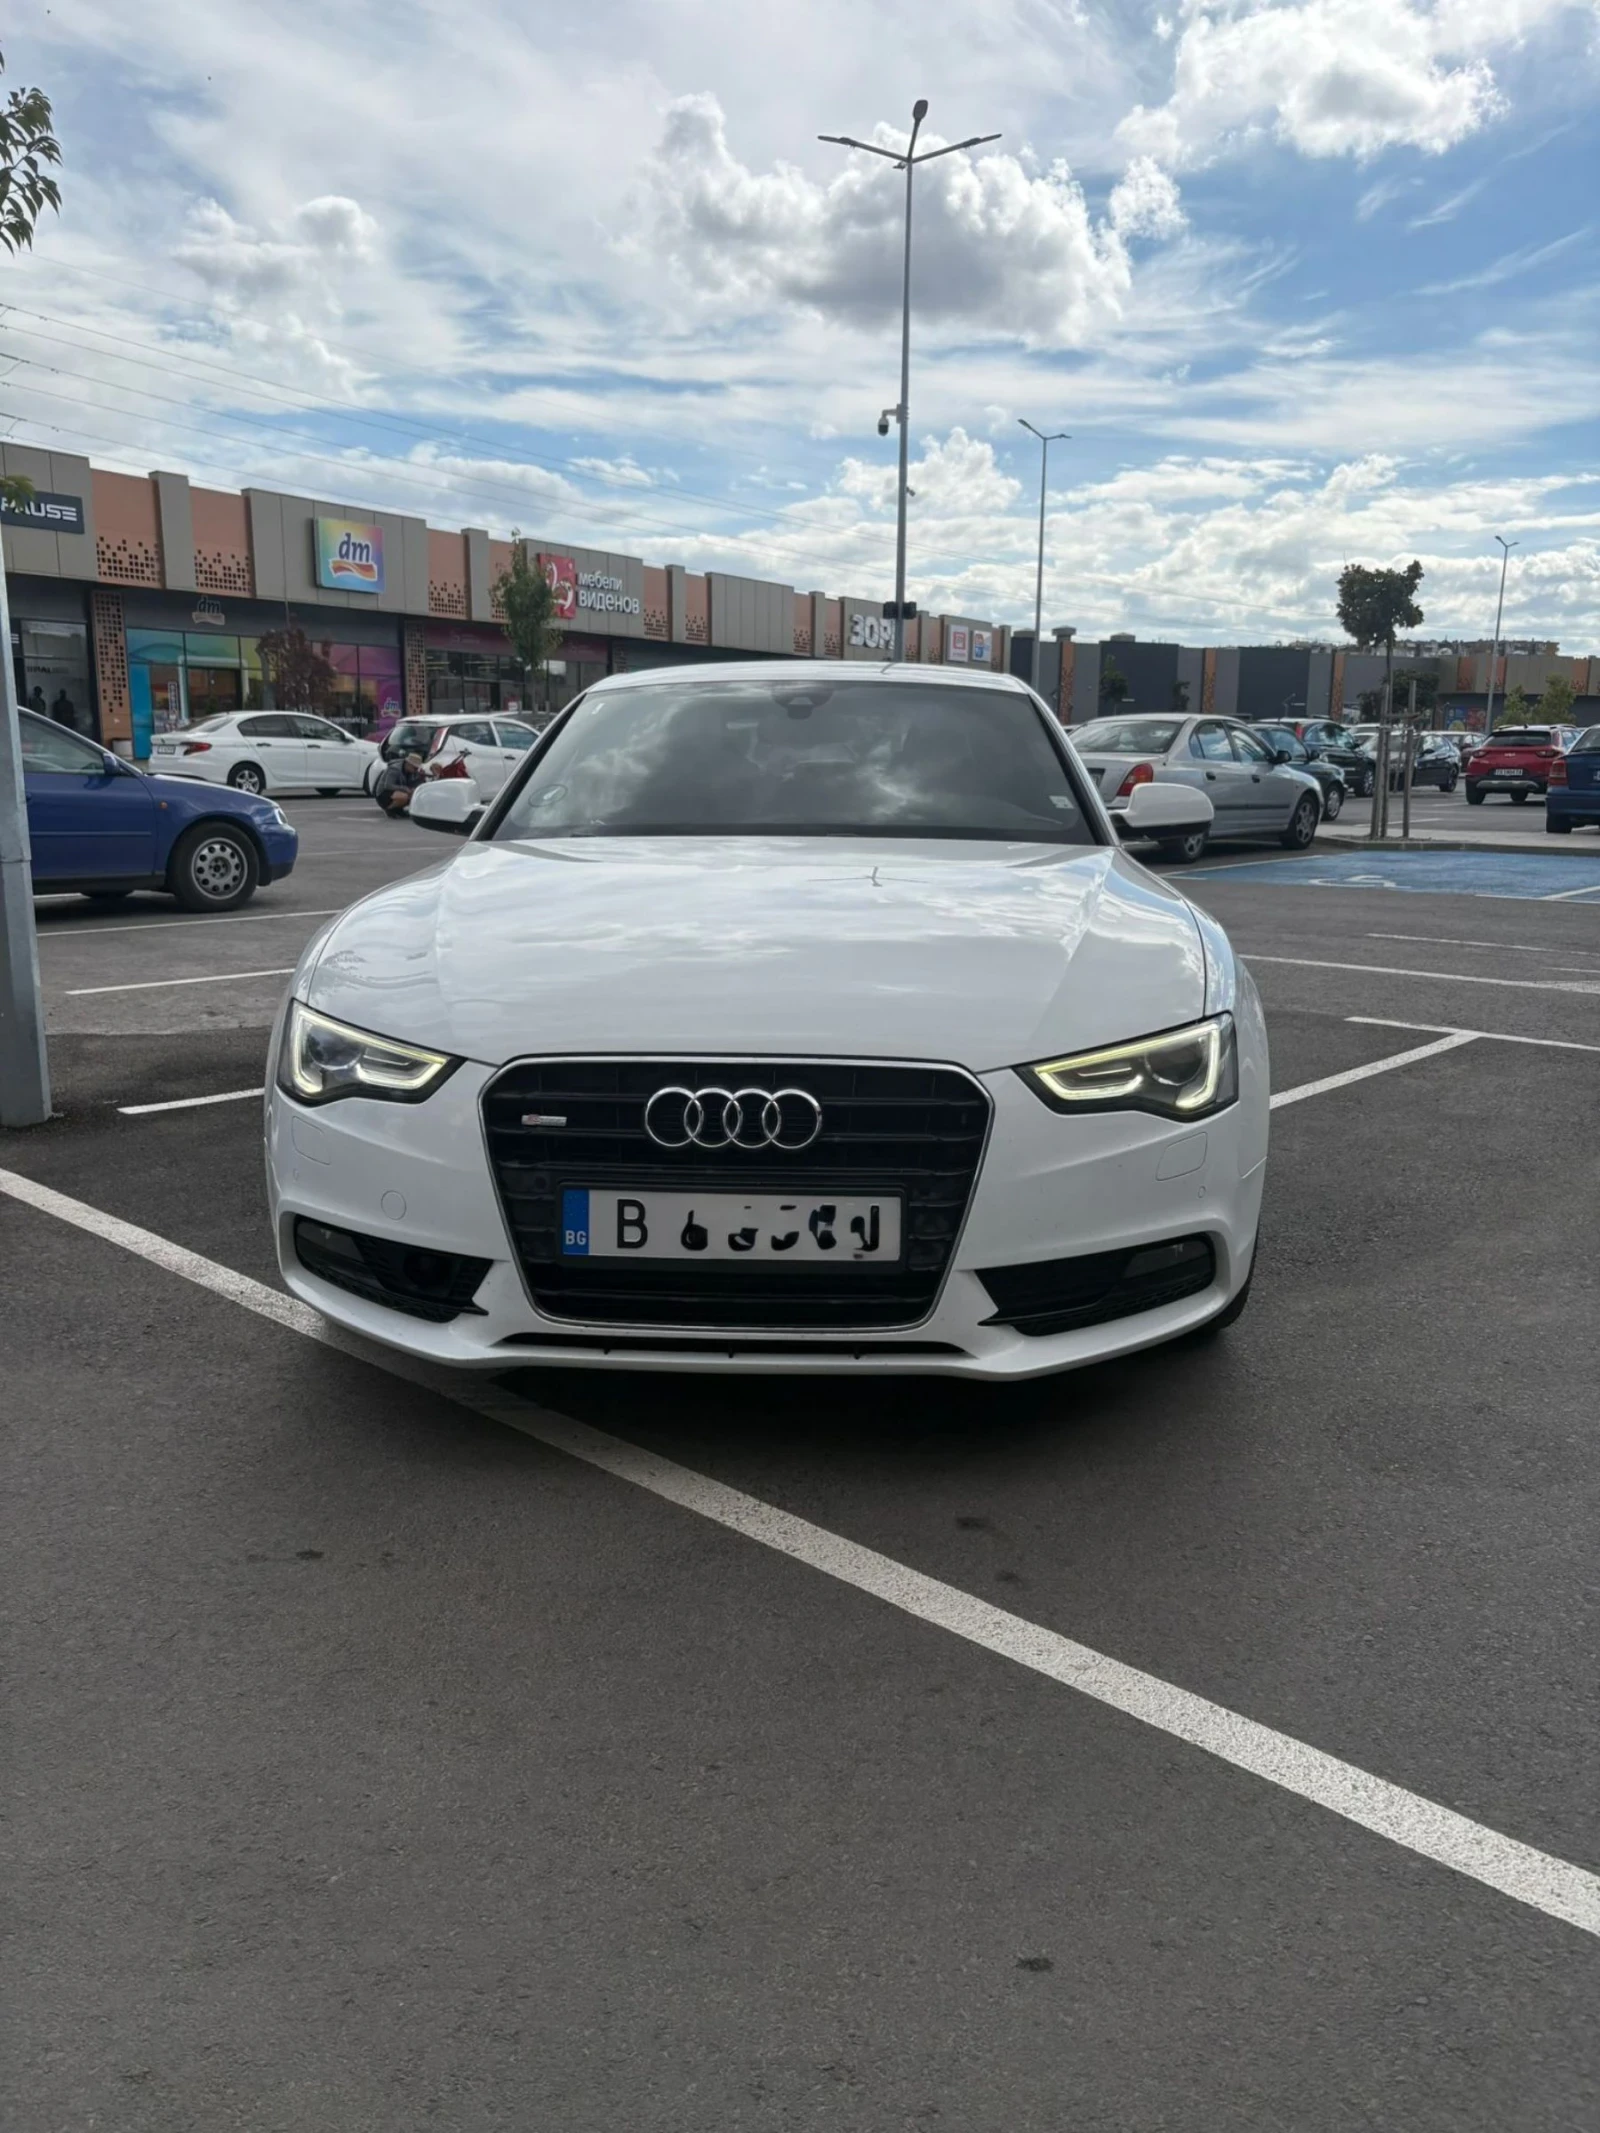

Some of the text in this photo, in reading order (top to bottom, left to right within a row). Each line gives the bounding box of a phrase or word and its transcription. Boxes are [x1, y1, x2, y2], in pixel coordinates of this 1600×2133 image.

[339, 533, 370, 563] dm
[578, 570, 623, 590] мебели
[198, 596, 220, 613] dm
[565, 1230, 587, 1246] BG
[617, 1199, 649, 1249] B
